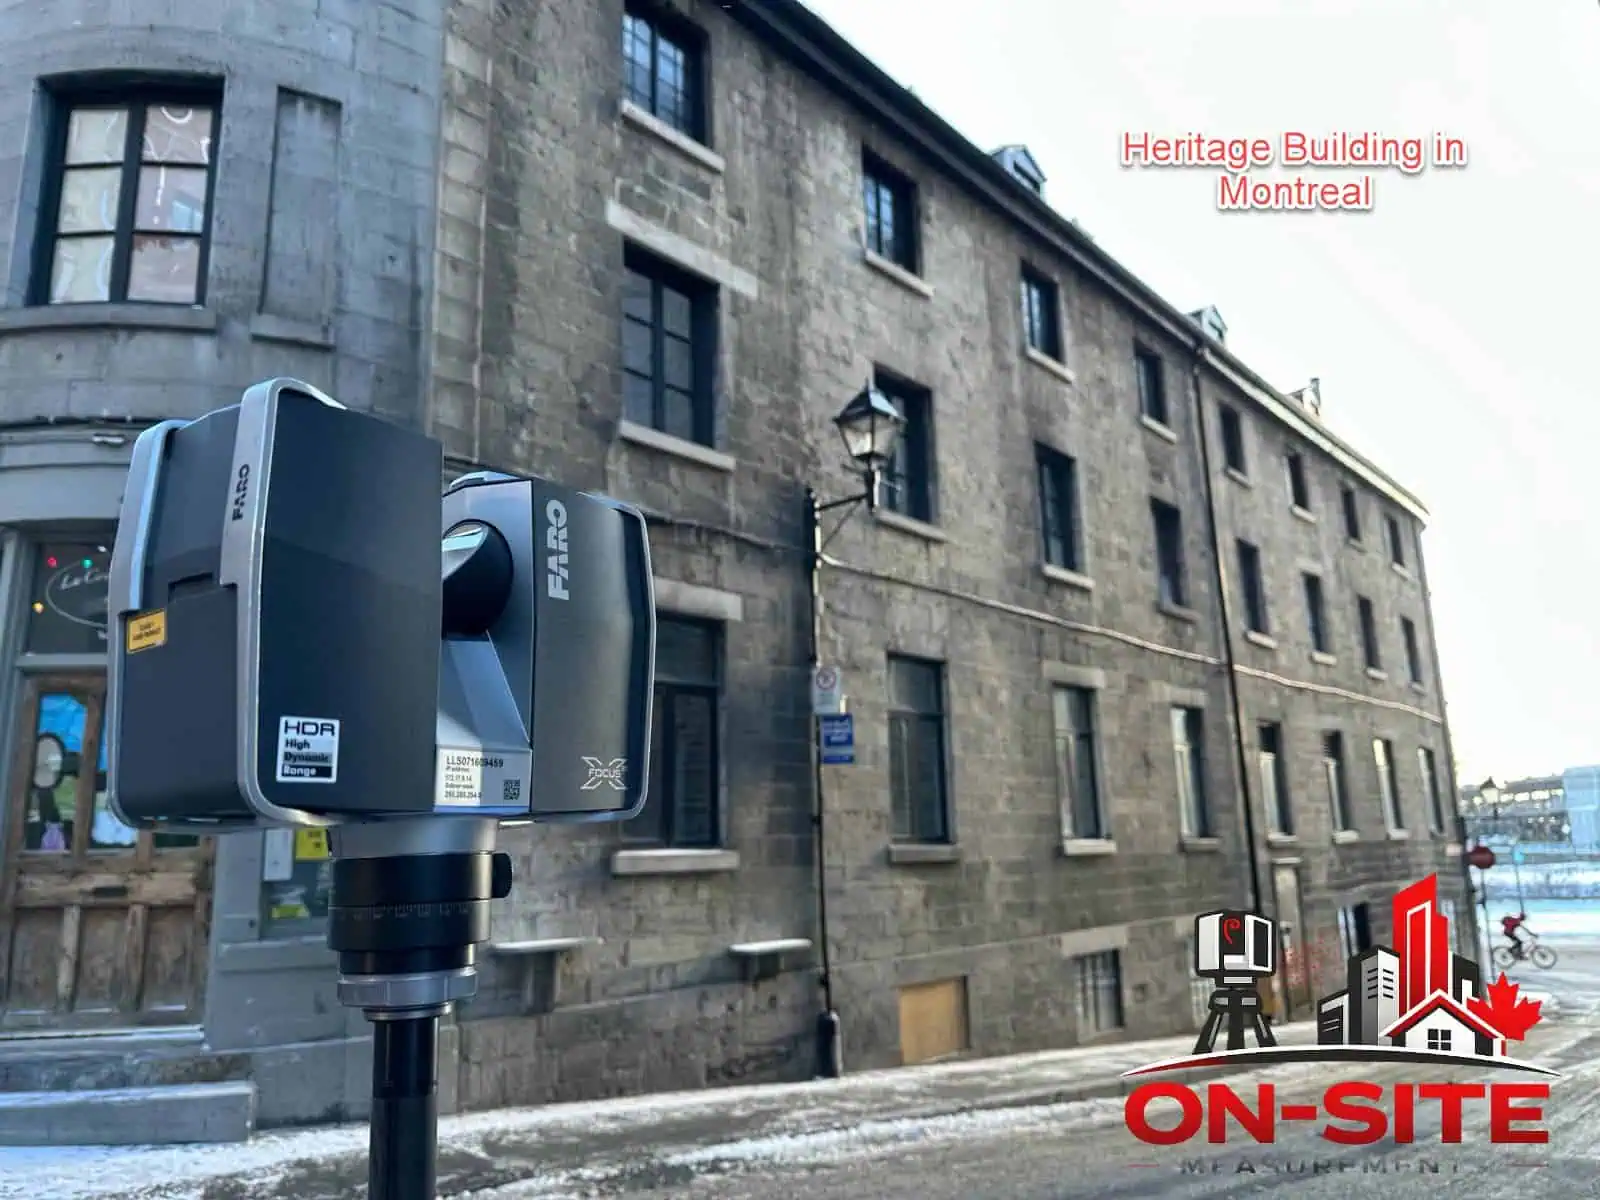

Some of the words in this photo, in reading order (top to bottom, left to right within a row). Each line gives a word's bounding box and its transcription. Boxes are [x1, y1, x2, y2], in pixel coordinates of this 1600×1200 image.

[232, 464, 250, 521] FARO
[546, 499, 569, 600] FARO
[284, 719, 336, 737] HDR
[285, 738, 311, 751] High
[284, 751, 329, 763] Dynamic
[283, 764, 318, 777] Range
[588, 768, 621, 778] FOCUS
